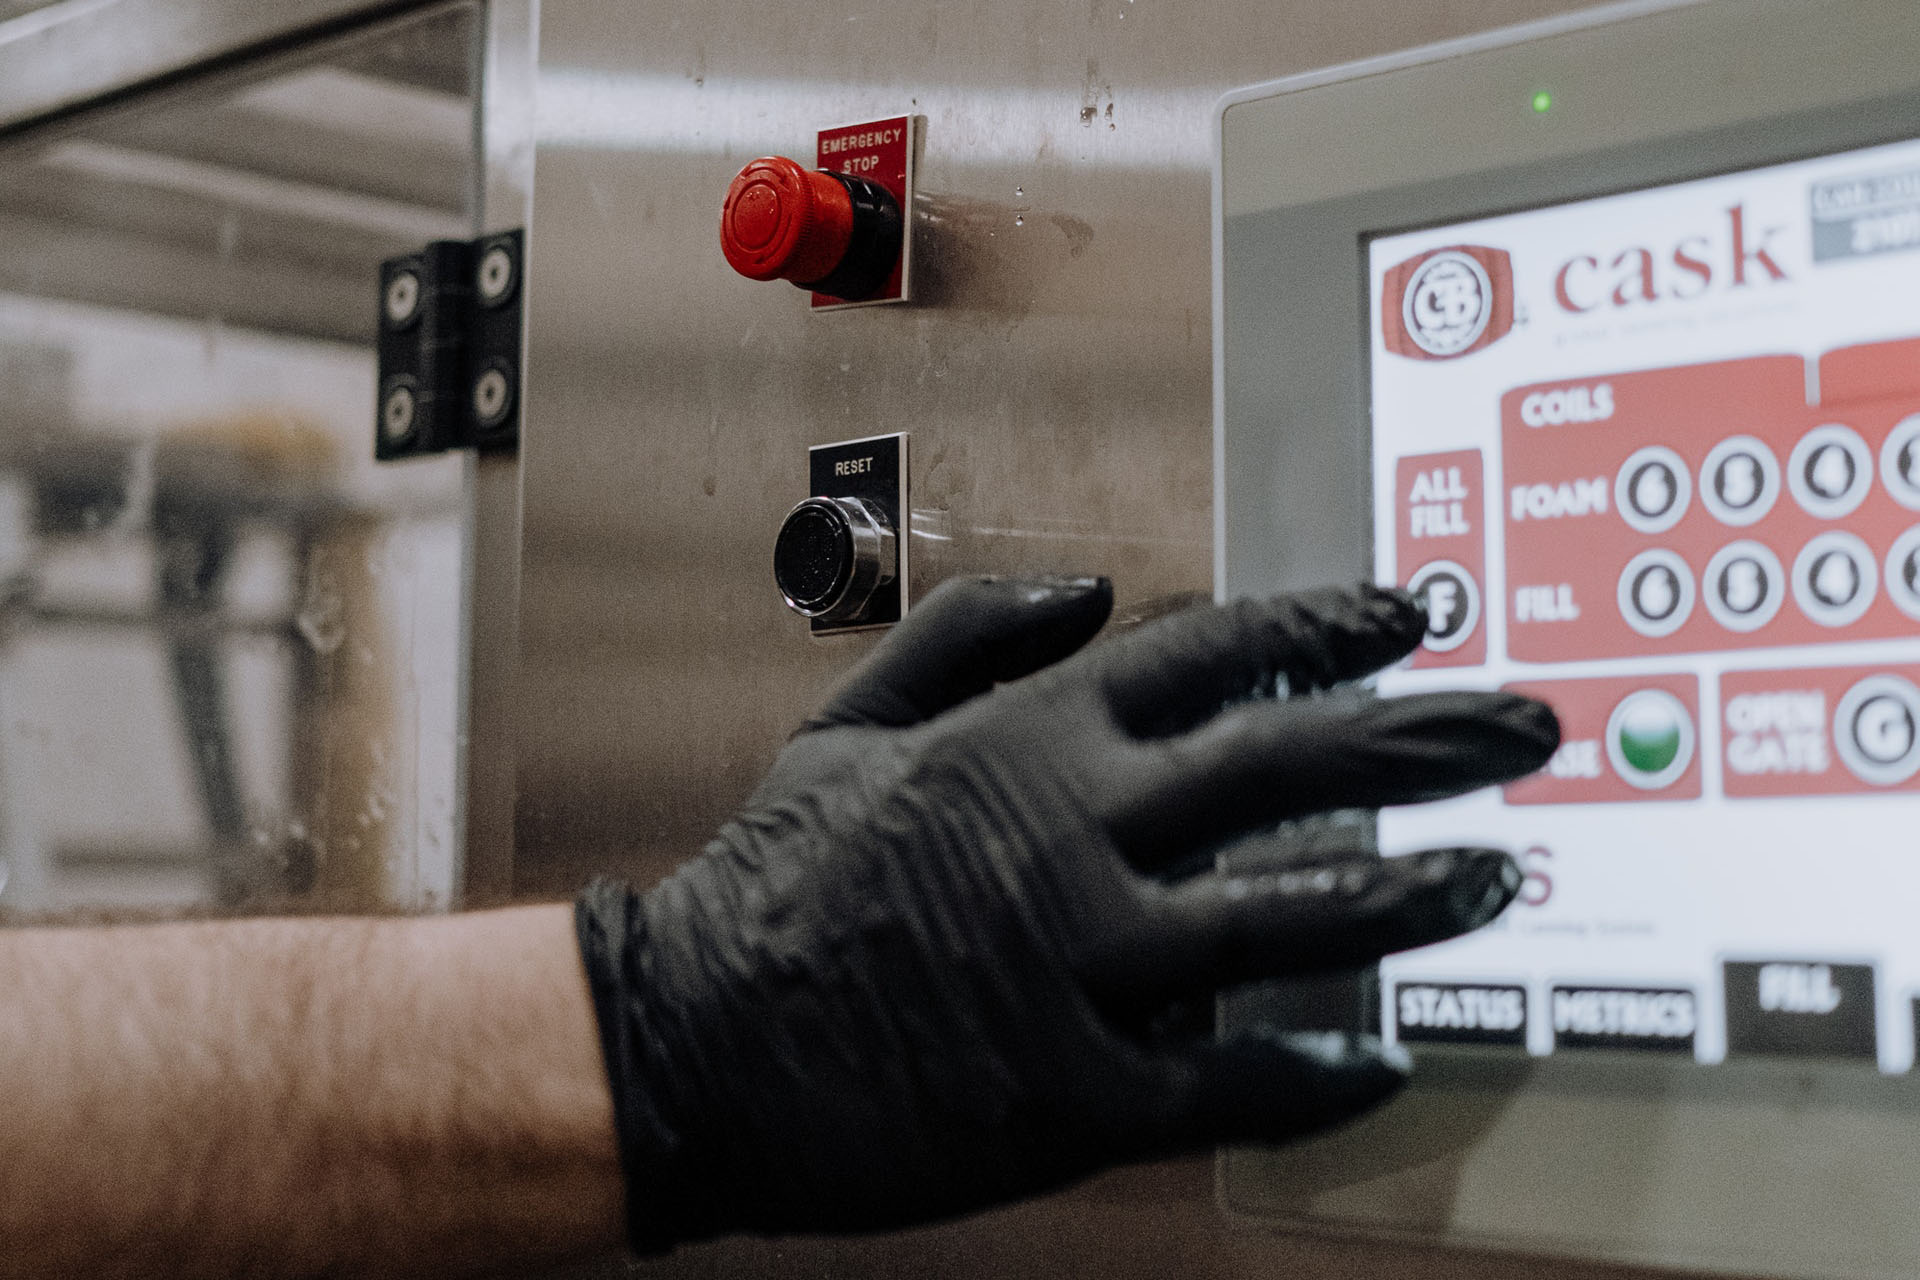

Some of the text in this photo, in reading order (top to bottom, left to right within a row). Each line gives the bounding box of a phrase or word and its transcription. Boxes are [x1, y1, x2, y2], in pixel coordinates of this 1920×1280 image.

[821, 128, 902, 155] EMERGENCY
[843, 155, 880, 175] STOP
[1553, 204, 1796, 314] cask
[1520, 383, 1615, 428] COILS
[834, 456, 874, 477] RESET
[1409, 466, 1468, 504] ALL
[1410, 502, 1470, 538] FILL
[1510, 477, 1609, 521] FOAM
[1427, 580, 1457, 633] F
[1515, 583, 1580, 623] FILL
[1725, 688, 1825, 733] OPEN
[1858, 698, 1908, 762] G
[1727, 733, 1831, 774] GATE
[1400, 963, 1841, 1038] STATUS METRICS FILL
